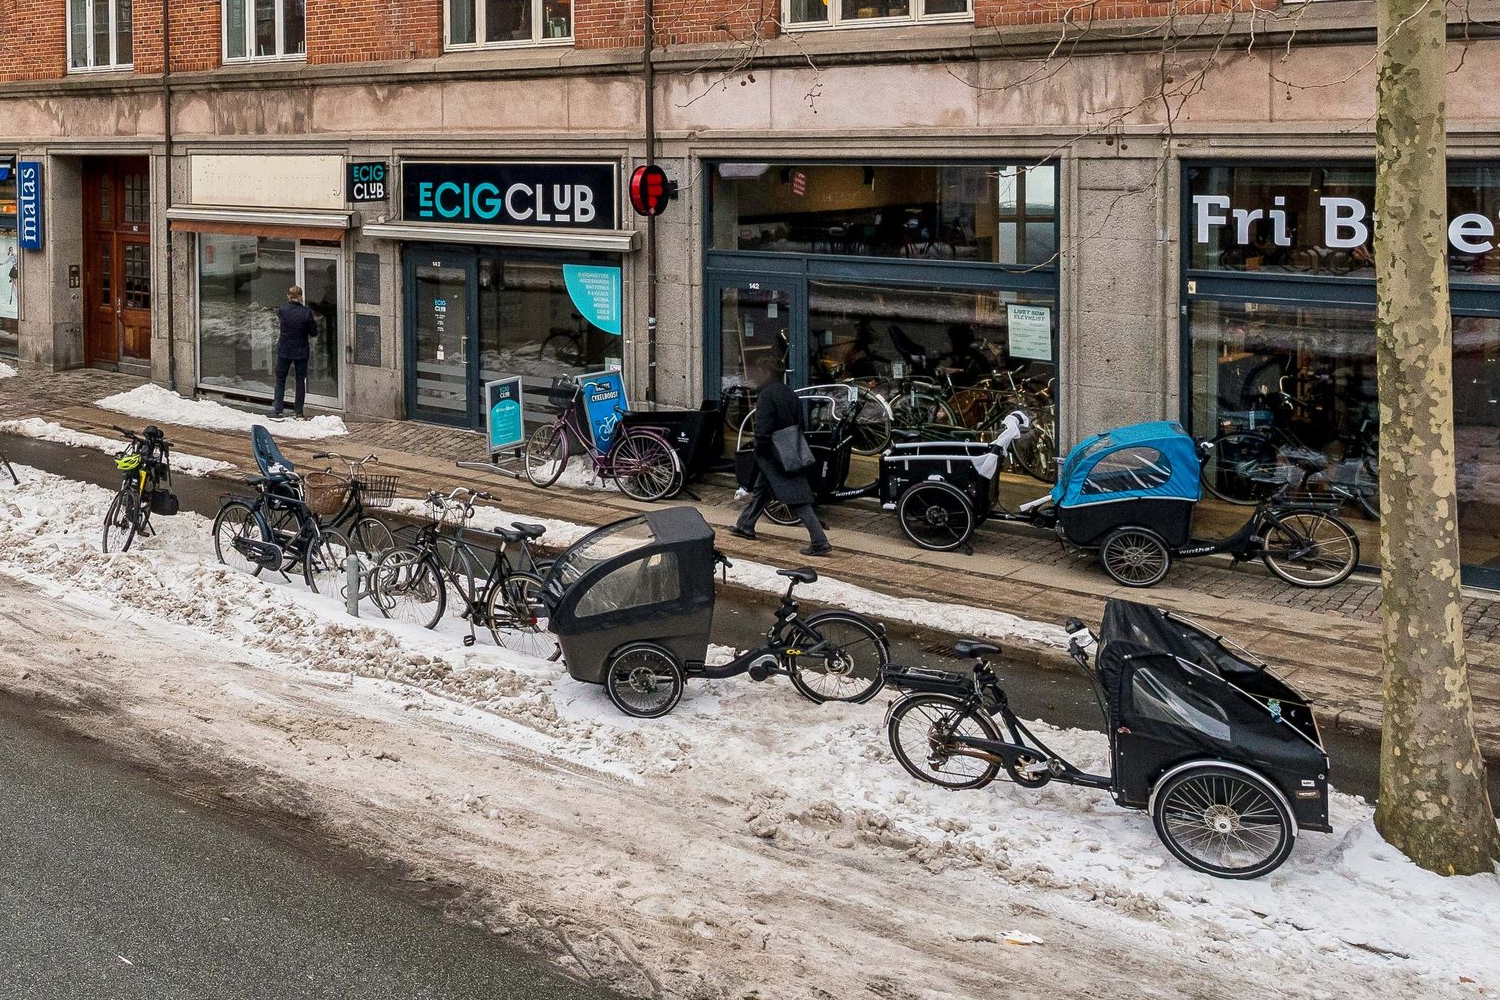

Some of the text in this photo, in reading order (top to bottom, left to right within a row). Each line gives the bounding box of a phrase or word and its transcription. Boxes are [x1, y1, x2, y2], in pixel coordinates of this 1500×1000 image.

[353, 165, 384, 182] ECIG
[353, 182, 384, 200] CLUB
[20, 167, 36, 243] matas
[1192, 195, 1291, 247] Fri
[1179, 546, 1215, 554] winther
